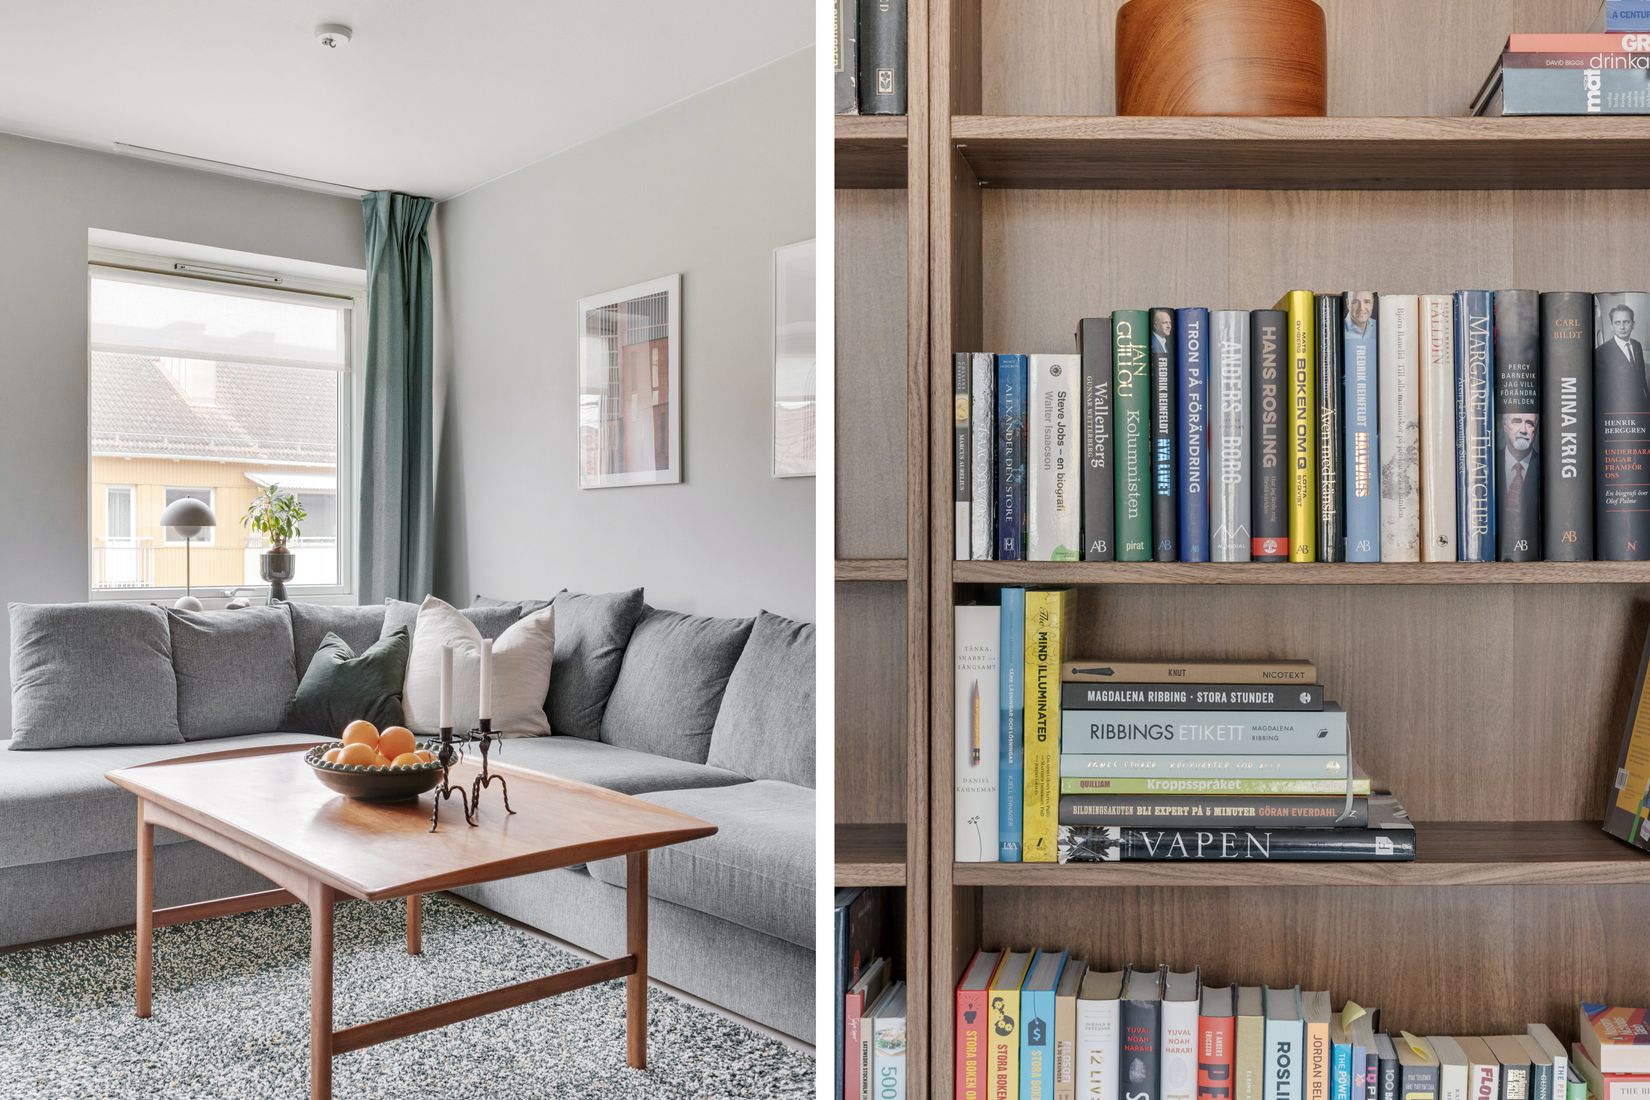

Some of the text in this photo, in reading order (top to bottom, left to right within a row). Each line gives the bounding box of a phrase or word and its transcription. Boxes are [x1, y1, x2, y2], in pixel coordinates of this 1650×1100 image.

[1612, 11, 1618, 19] A
[1431, 302, 1446, 365] FÄLLDIN
[1553, 331, 1583, 339] BILDT
[1555, 319, 1580, 327] CARL
[1188, 321, 1200, 363] TRON
[1262, 327, 1277, 379] HANS
[1116, 321, 1133, 398] GUILLOU
[1131, 345, 1147, 376] JAN
[1188, 369, 1203, 387] PÅ
[1221, 341, 1242, 412] ANDERS
[1357, 345, 1367, 428] FREDRIK REINFELDT
[1158, 357, 1169, 434] FREDRIK REINFELDT
[1091, 382, 1108, 468] Wallenberg
[1262, 384, 1277, 468] ROSLING
[1296, 358, 1307, 470] BOKEN OM Q
[1321, 406, 1336, 438] Även
[1469, 315, 1491, 536] MARGARET THATCHER
[1561, 377, 1577, 478] MINA KRIG
[1044, 391, 1054, 470] Walter Isaacson
[1188, 393, 1201, 494] FÖRÄNDRING
[1456, 412, 1468, 449] Downing
[1005, 384, 1013, 522] ALEXANDER DEN STORE
[1055, 391, 1067, 512] Steve Jobs en biografi
[1126, 409, 1140, 519] Kolumnisten
[1221, 436, 1242, 484] BORG
[1321, 444, 1337, 477] med
[1354, 432, 1371, 497] HALVVÄGS
[1459, 451, 1468, 474] Street
[1157, 439, 1171, 496] NYA LIVET
[1604, 463, 1642, 471] FRAMFÖR
[1321, 479, 1337, 521] känsla
[1605, 497, 1618, 505] Olof
[1615, 490, 1637, 498] biografi
[1090, 540, 1107, 553] AB
[1126, 541, 1144, 552] pirat
[1158, 540, 1172, 549] AB
[1296, 545, 1309, 554] AB
[1355, 540, 1371, 552] AB
[1513, 539, 1529, 551] AB
[1561, 530, 1577, 543] AB
[1038, 606, 1049, 627] The
[1037, 632, 1048, 742] MIND ILLUMINATED
[1168, 669, 1306, 679] KNUT NICOTEXT
[1087, 690, 1275, 704] MAGDALENA RIBBING STORA STUNDER
[1090, 724, 1245, 741] RIBBINGS ETIKETT
[1080, 780, 1111, 789] QUILLIAM
[1147, 779, 1242, 792] Kroppsspråket
[1073, 805, 1337, 817] BILDNINGSAKUTEN BLI EXPERT PÅ 5 MINUTER GÖRAN EVERDAHL
[1140, 832, 1273, 858] VAPEN
[966, 1030, 977, 1088] STORA BOKEN
[997, 1044, 1008, 1072] STORA
[1031, 1050, 1042, 1078] STORA
[1062, 1041, 1072, 1083] FILOSOFI
[1090, 1050, 1102, 1065] 12
[1313, 1034, 1323, 1078] JORDAN
[1338, 1053, 1346, 1069] THE
[881, 1066, 898, 1099] 500
[1385, 1069, 1395, 1091] 100
[1557, 1065, 1565, 1081] THE
[1621, 1087, 1638, 1095] THE
